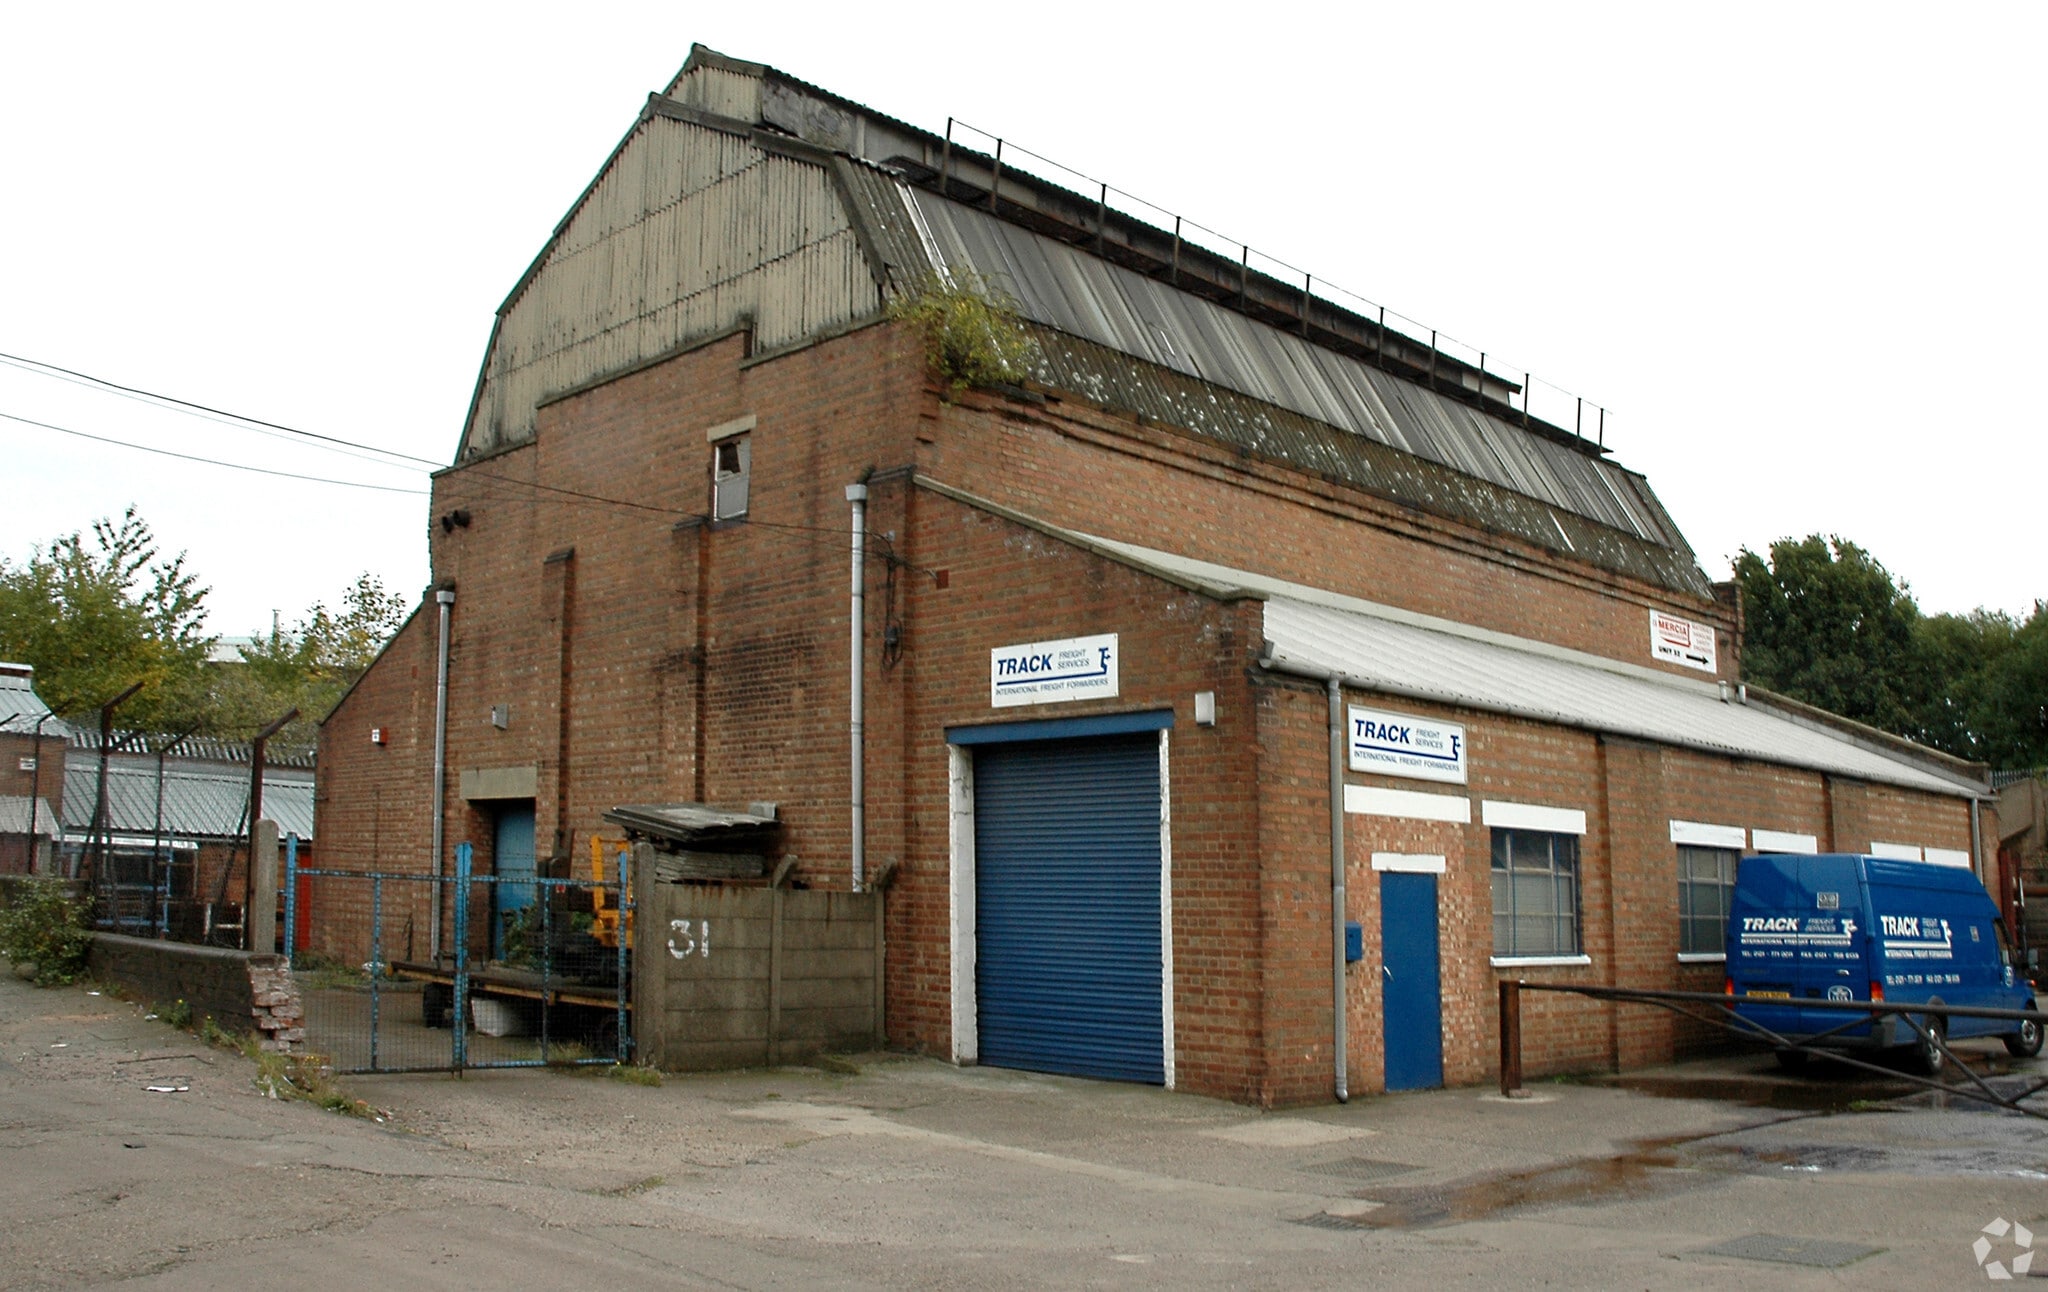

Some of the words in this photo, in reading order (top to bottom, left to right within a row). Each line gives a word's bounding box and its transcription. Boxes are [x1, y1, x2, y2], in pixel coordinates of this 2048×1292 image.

[1658, 620, 1687, 635] MERCIA
[1059, 649, 1087, 660] FREIGHT
[1658, 645, 1672, 654] UNIT
[997, 653, 1053, 676] TRACK
[1057, 658, 1090, 670] SERVICES
[995, 685, 1038, 696] INTERNATIONAL
[1040, 682, 1065, 692] FREIGHT
[1066, 678, 1109, 690] FORWARDERS
[1355, 719, 1410, 744] TRACK
[1416, 728, 1440, 739] FREIGHT
[1415, 738, 1443, 750] SERVICES
[1354, 750, 1398, 764] INTERNATIONAL
[1399, 756, 1422, 767] FREIGHT
[1424, 760, 1460, 772] FORWARDERS
[1743, 917, 1799, 932] TRACK
[1880, 915, 1920, 937] TRACK
[668, 919, 709, 960] 31
